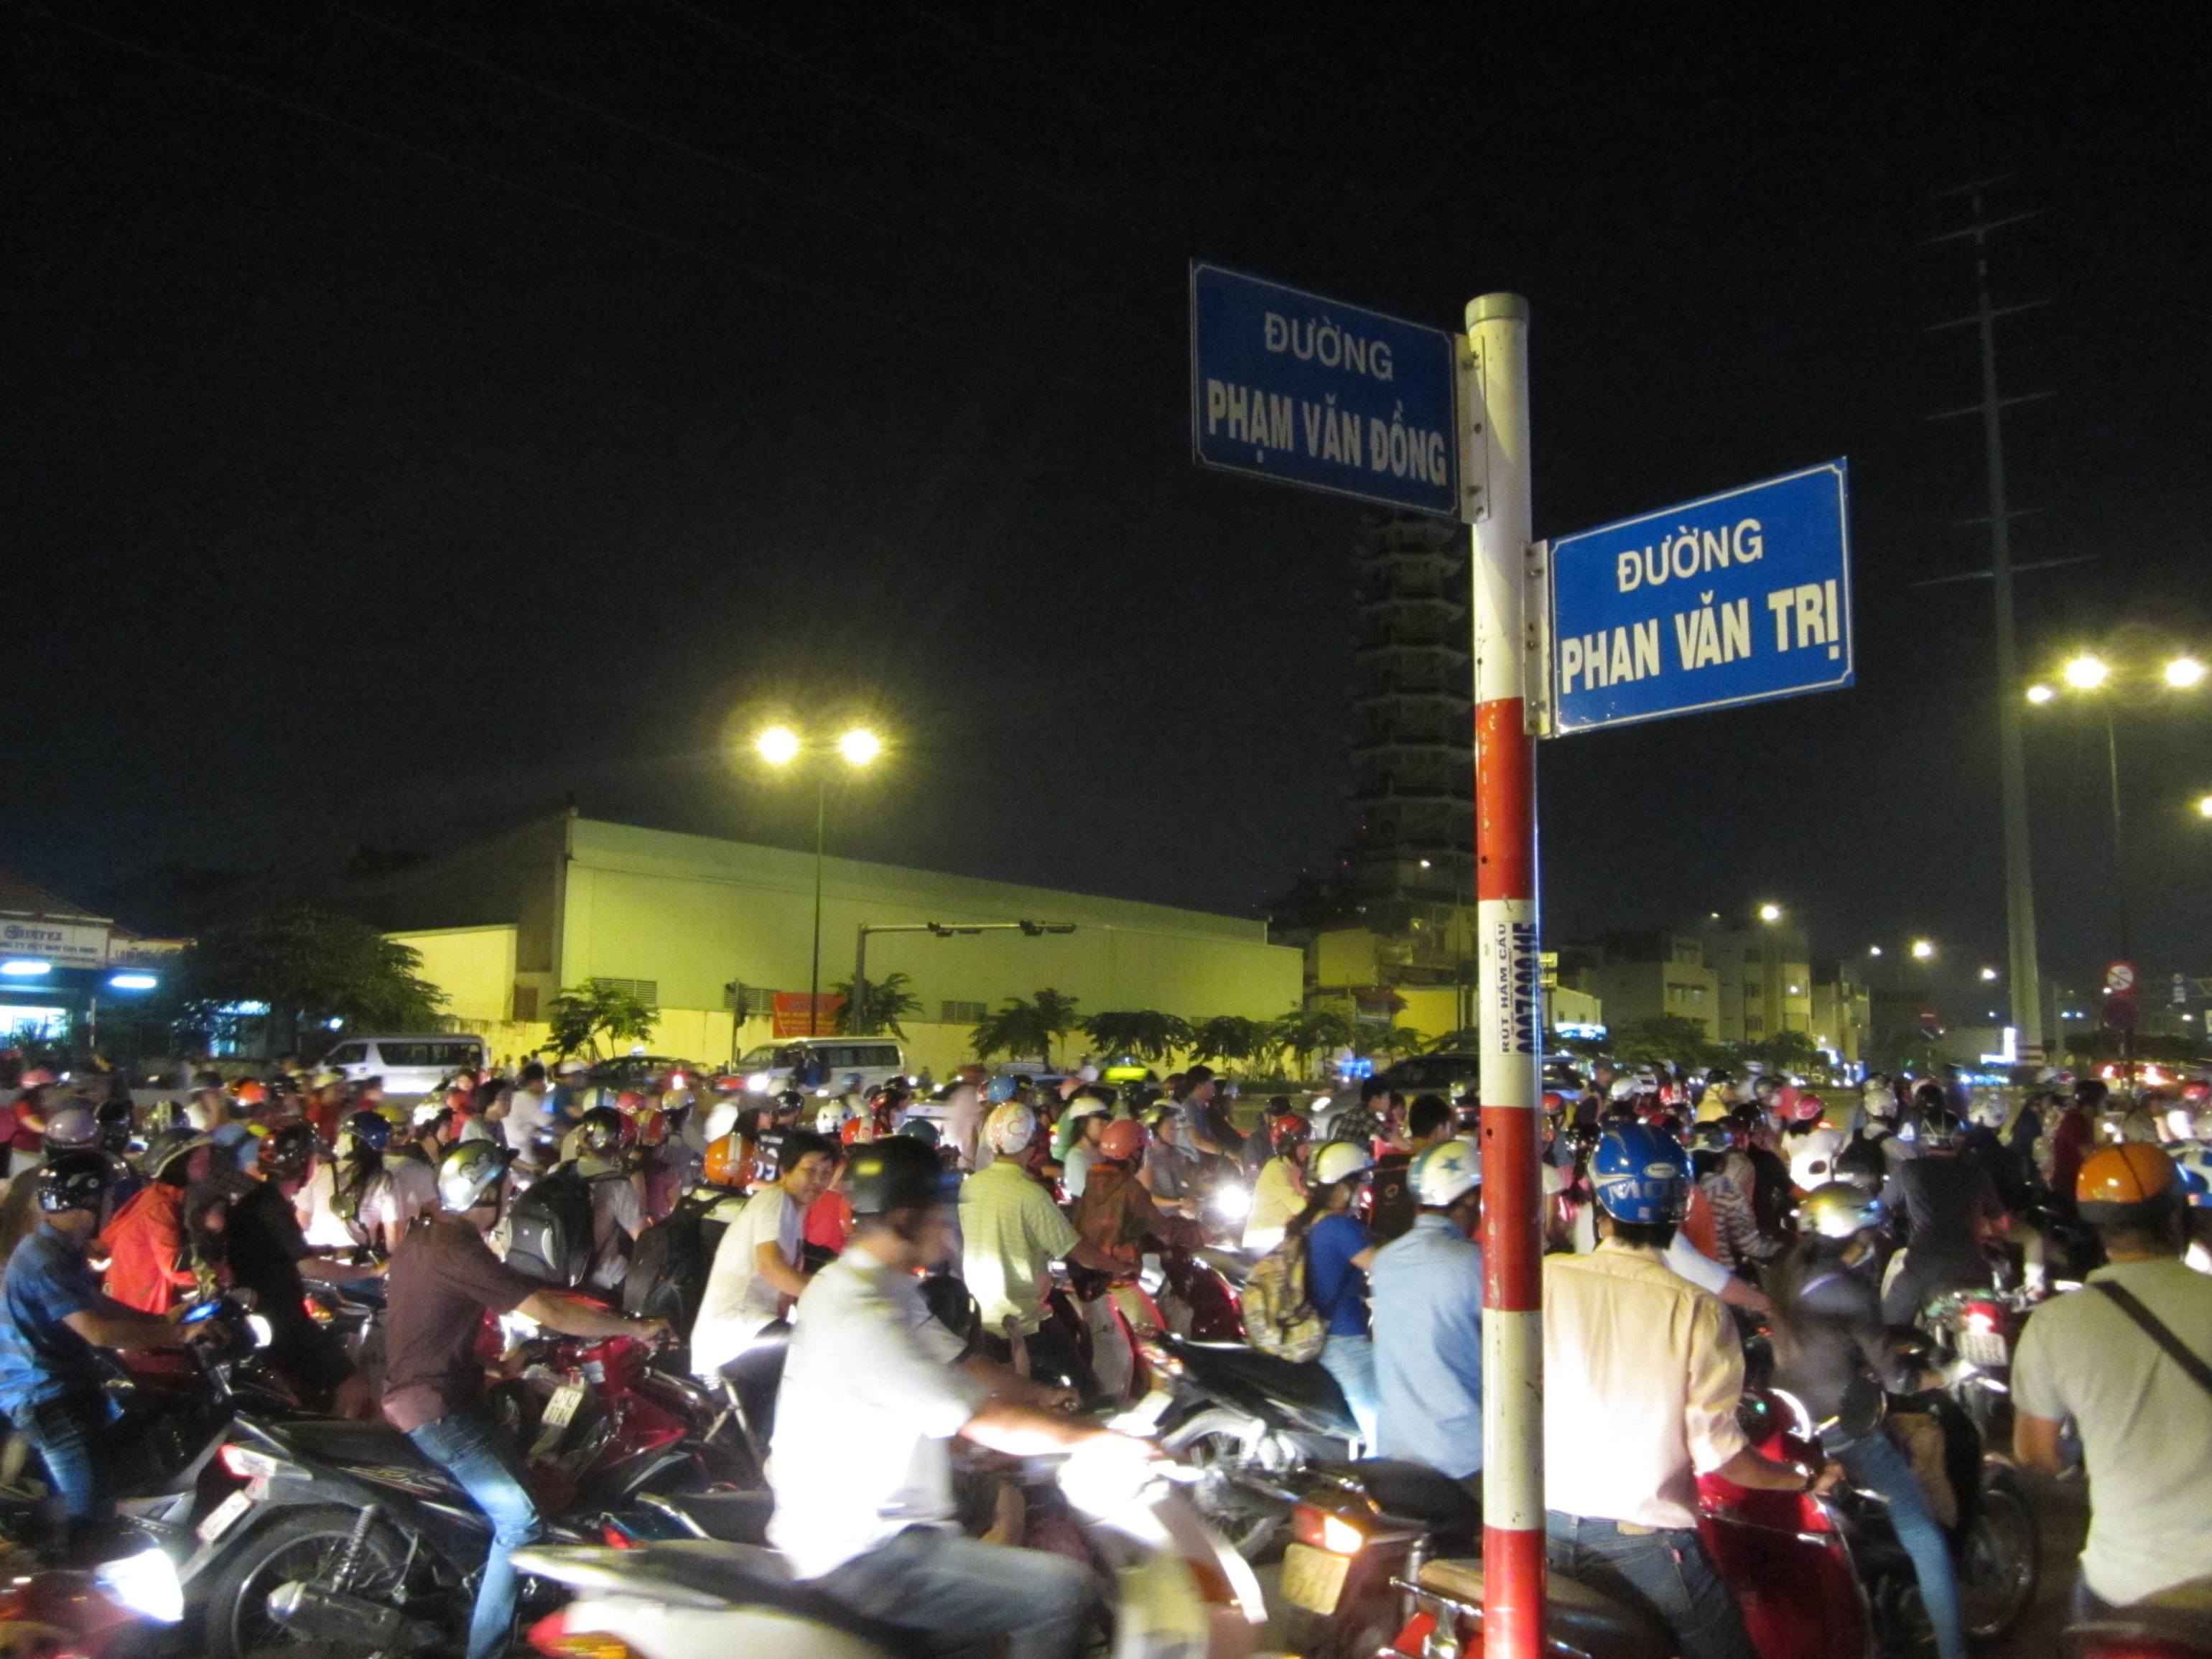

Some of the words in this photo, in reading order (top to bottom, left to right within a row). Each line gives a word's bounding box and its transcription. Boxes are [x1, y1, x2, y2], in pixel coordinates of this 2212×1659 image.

[1264, 312, 1393, 381] ĐƯỜNG
[1208, 378, 1293, 463] PHẠM
[1303, 393, 1362, 467] VĂN
[1370, 400, 1447, 486] ĐỒNG
[1617, 519, 1763, 592] ĐƯỜNG
[1561, 619, 1660, 694] PHAN
[1675, 590, 1751, 671] VĂN
[1767, 580, 1840, 660] TRỊ
